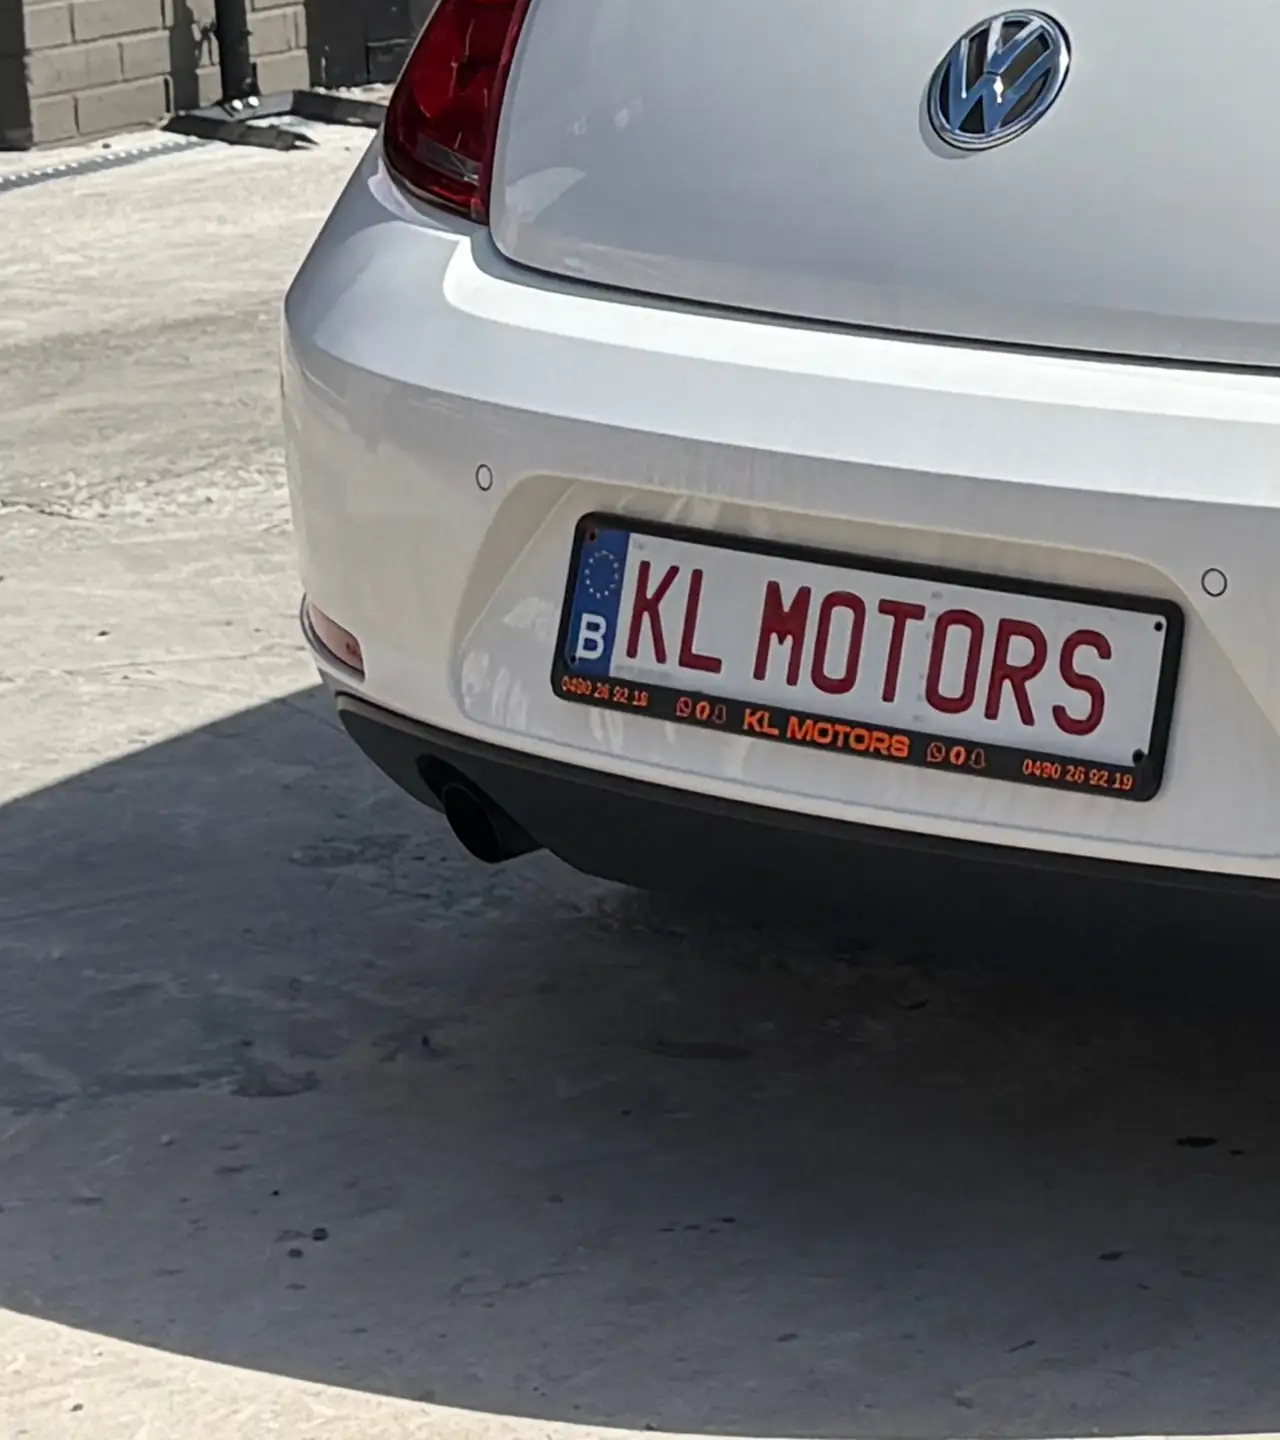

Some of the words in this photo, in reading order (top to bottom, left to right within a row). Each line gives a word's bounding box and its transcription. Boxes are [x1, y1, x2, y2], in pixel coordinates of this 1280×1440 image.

[575, 612, 607, 660] B
[625, 560, 723, 674] KL
[753, 580, 1112, 736] MOTORS
[742, 708, 780, 737] KL
[786, 715, 911, 758] MOTORS
[1112, 772, 1134, 790] 19
